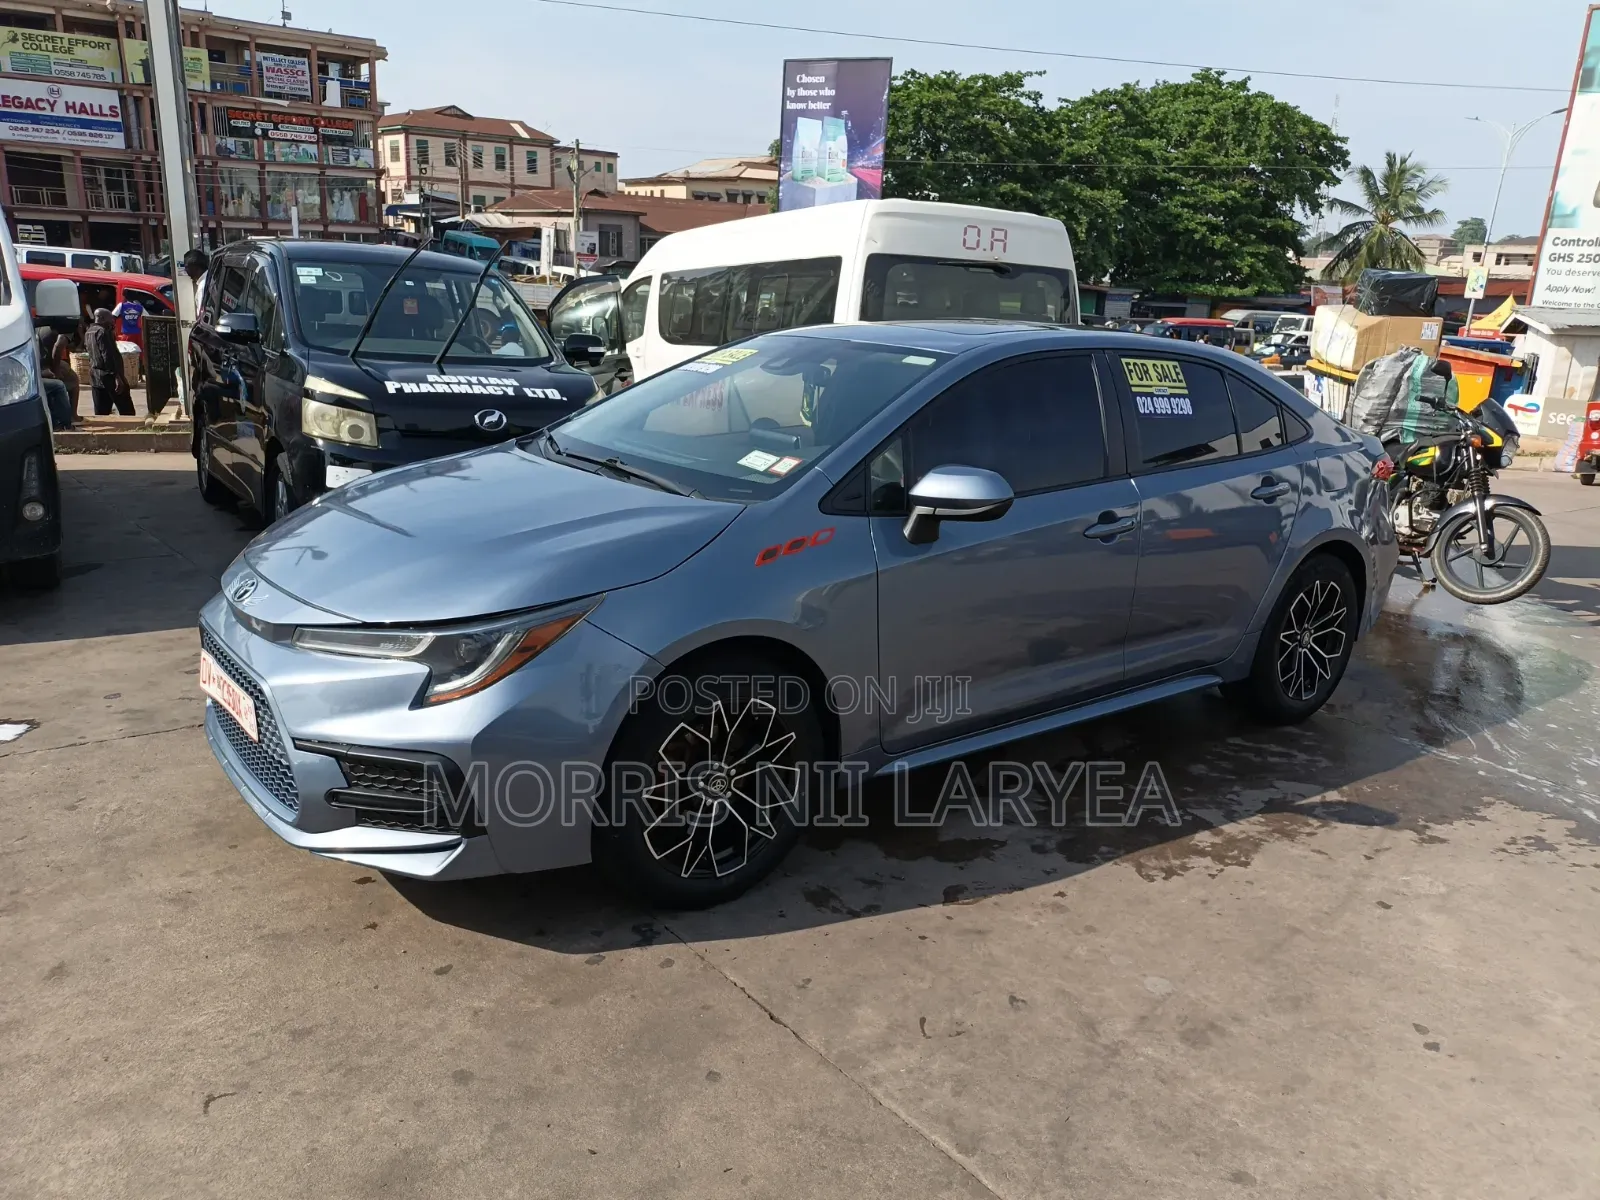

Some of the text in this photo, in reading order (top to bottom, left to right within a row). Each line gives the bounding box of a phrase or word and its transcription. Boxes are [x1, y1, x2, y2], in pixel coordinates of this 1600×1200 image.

[21, 32, 111, 50] SECRET EFFORT
[22, 42, 75, 55] COLLEGE
[54, 69, 76, 77] 0558
[77, 71, 91, 79] 745
[266, 66, 306, 77] WASSCE
[796, 74, 825, 83] Chosen
[787, 87, 835, 98] by those who
[0, 95, 119, 118] EGACY HALLS
[786, 100, 832, 110] know better
[228, 110, 354, 129] SECRET EFFORT COLLEGE
[1548, 252, 1574, 263] GHS
[1546, 267, 1562, 276] You
[1545, 284, 1596, 294] Apply Now!
[1542, 299, 1572, 307] Welcome
[1574, 300, 1581, 308] to
[1583, 301, 1595, 309] the
[1124, 361, 1184, 384] FOR SALE
[426, 374, 519, 386] ADIYIAH
[384, 381, 567, 401] PHARMACY LTD.
[1136, 396, 1154, 414] 024
[1153, 397, 1171, 414] 999
